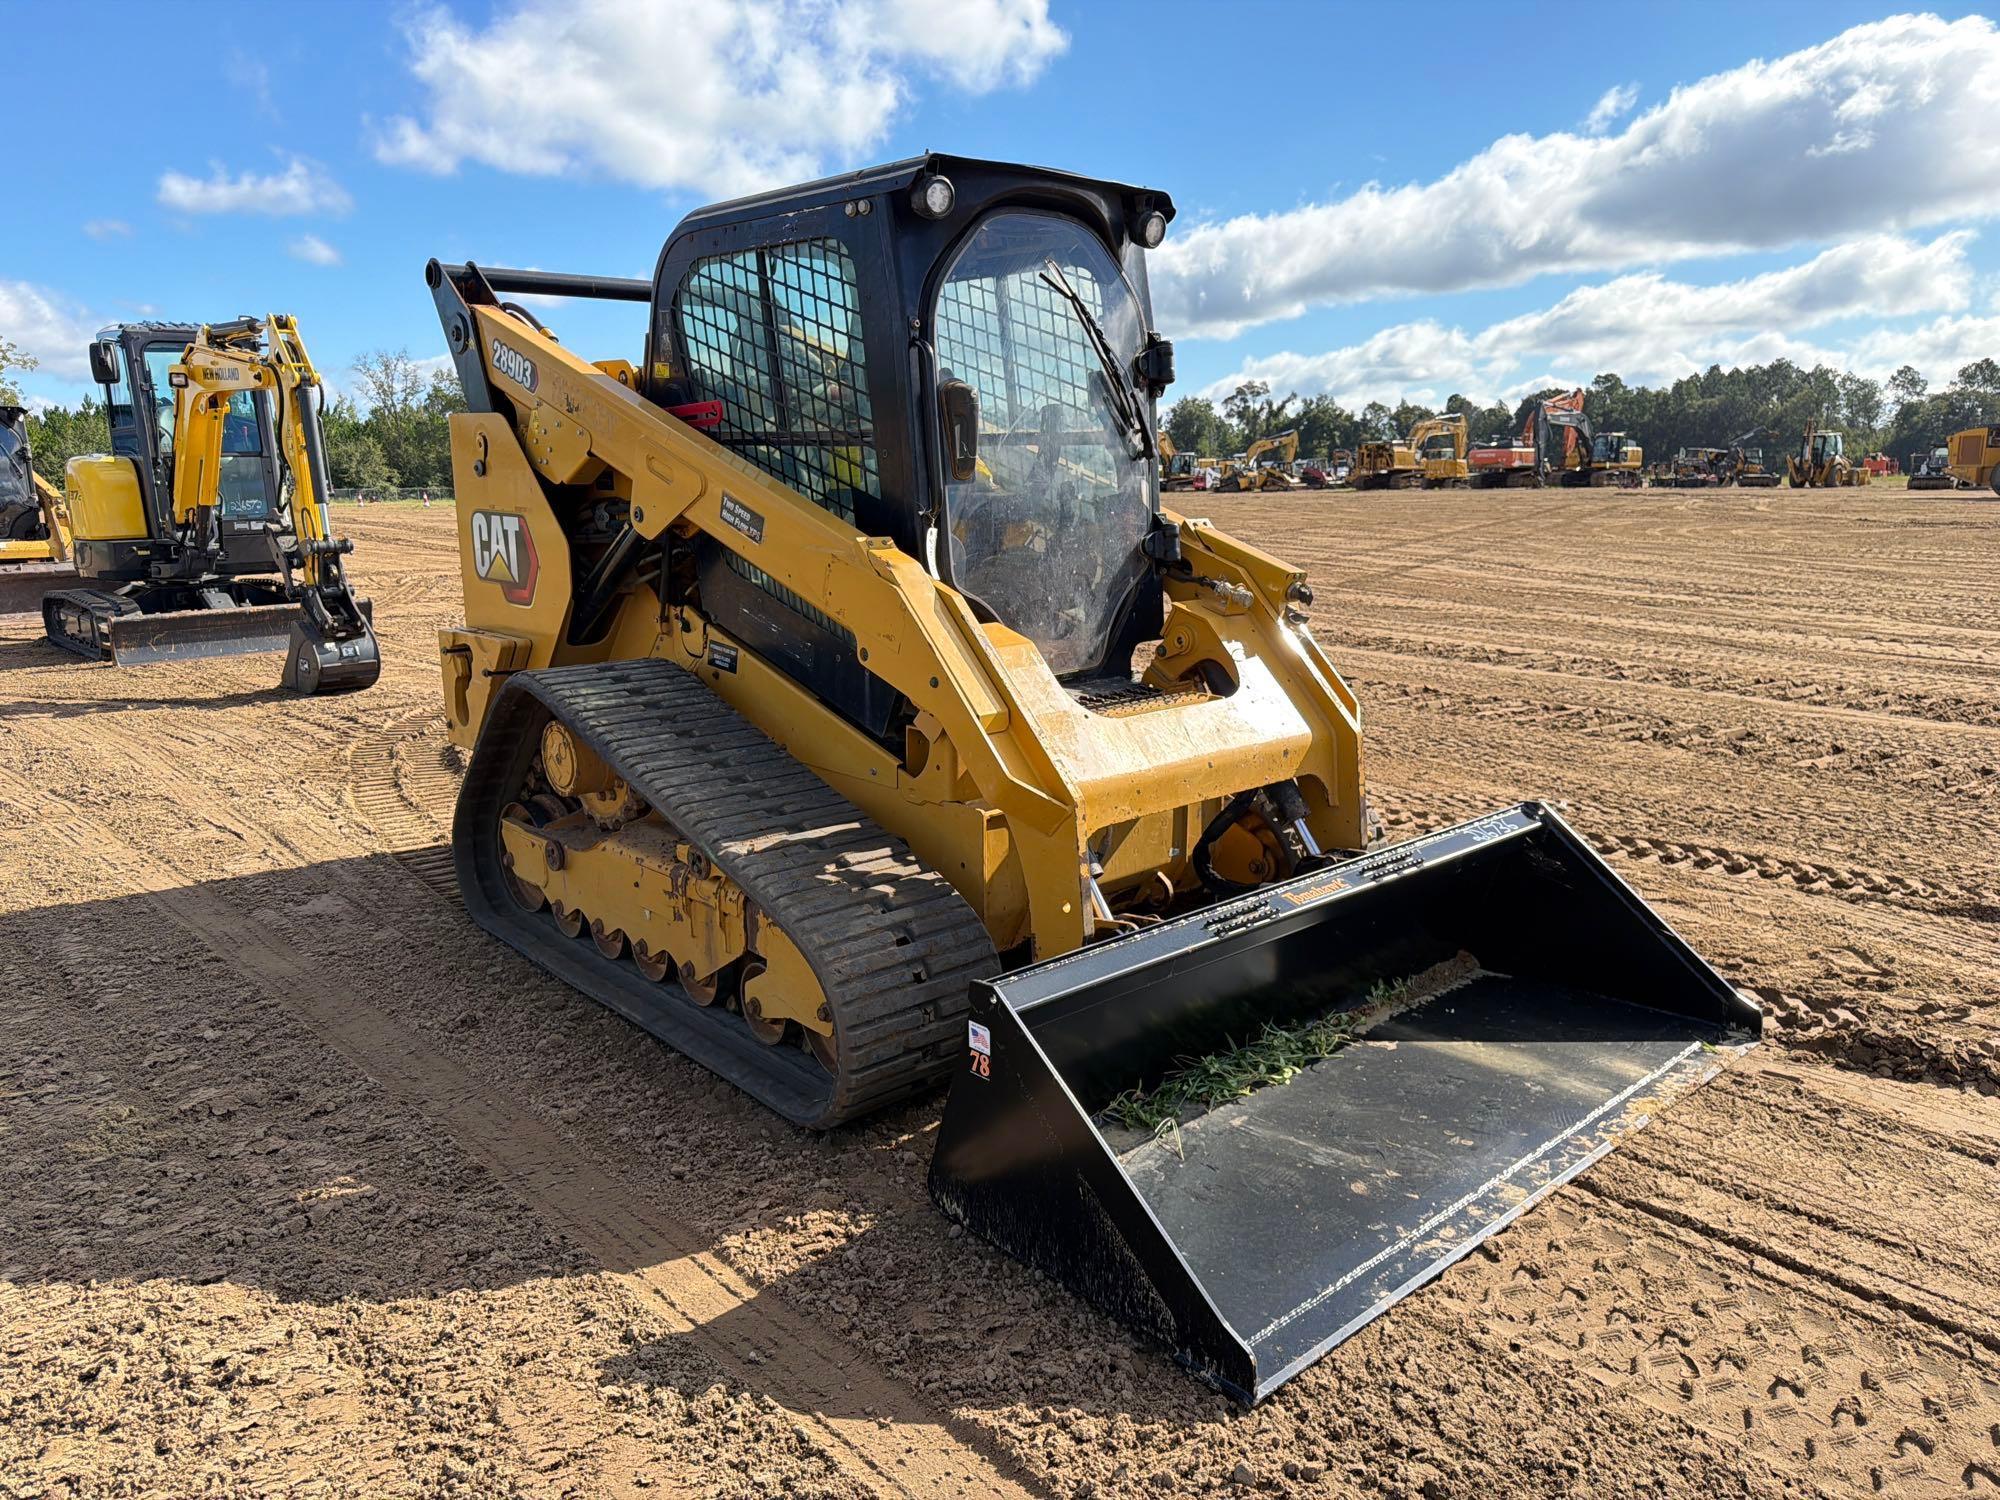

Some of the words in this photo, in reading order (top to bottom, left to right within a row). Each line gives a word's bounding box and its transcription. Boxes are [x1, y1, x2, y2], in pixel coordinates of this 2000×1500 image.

[202, 367, 215, 380] NEW
[215, 367, 239, 380] HOLLAND
[493, 341, 532, 389] 289D3
[472, 512, 520, 583] CAT
[1281, 878, 1346, 905] Tomahawk
[970, 1050, 990, 1077] 78
